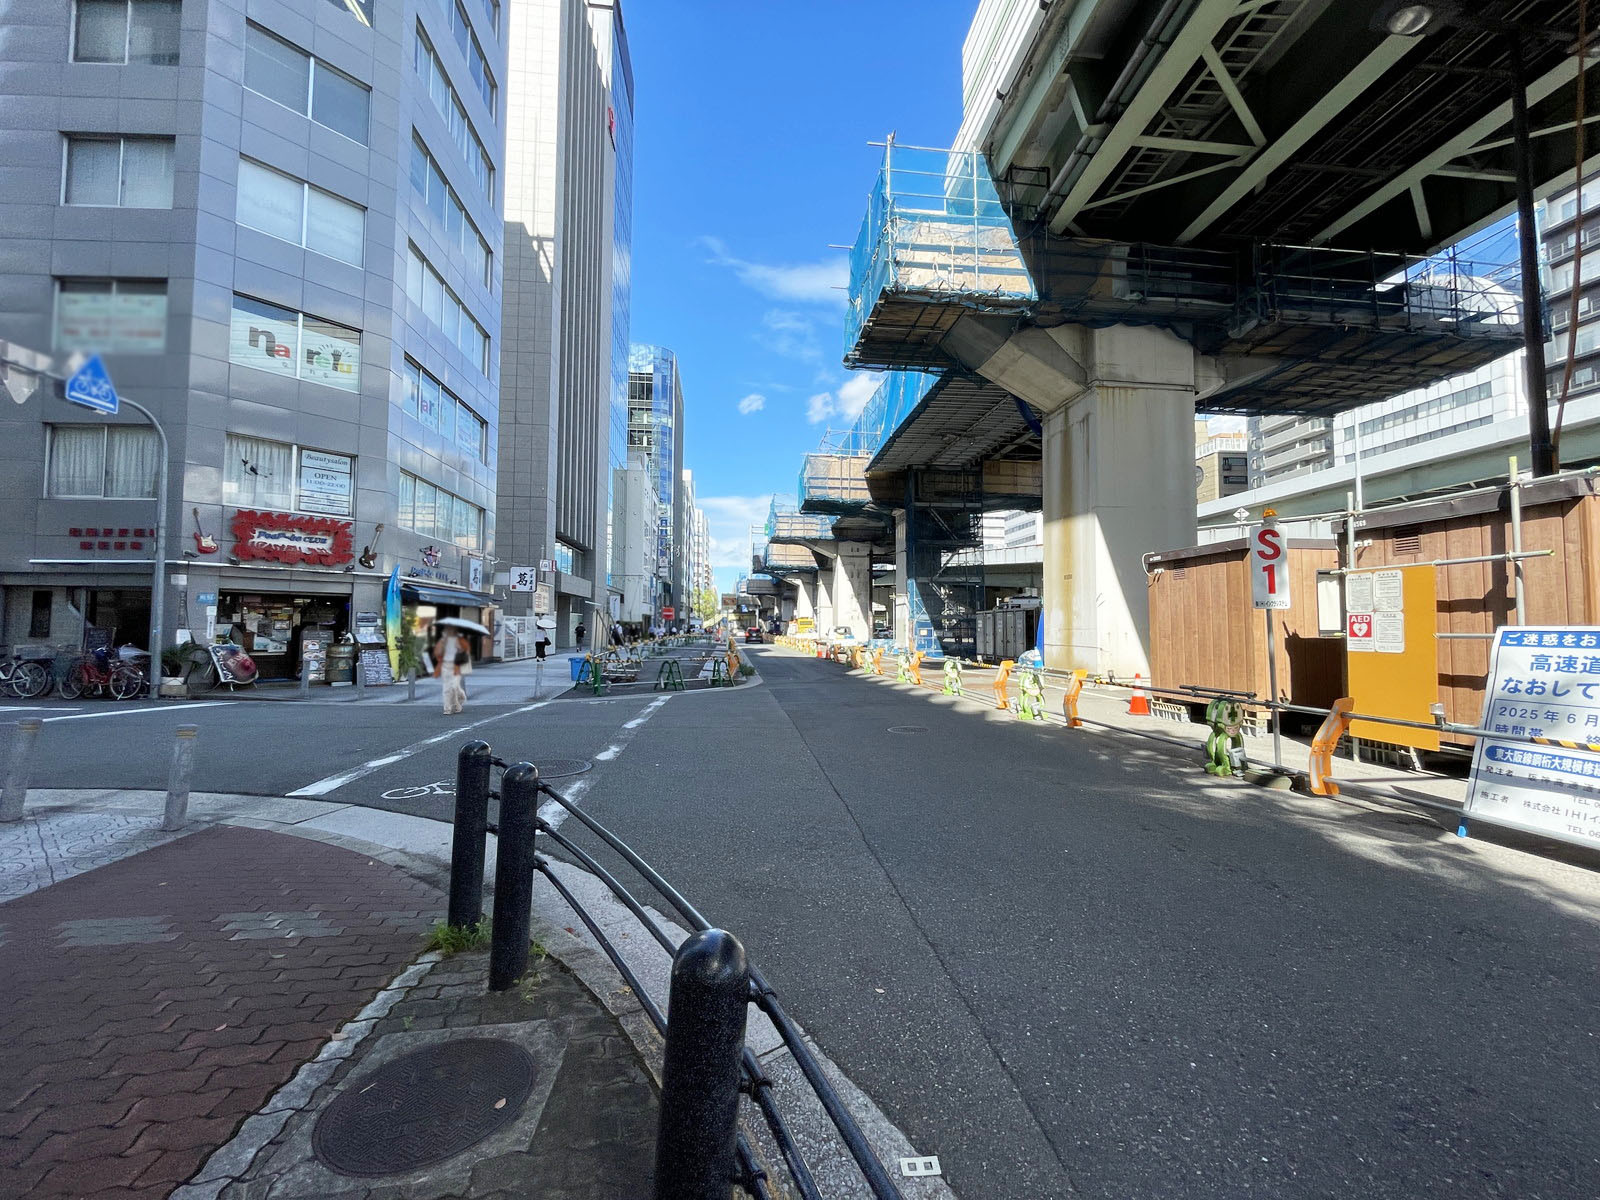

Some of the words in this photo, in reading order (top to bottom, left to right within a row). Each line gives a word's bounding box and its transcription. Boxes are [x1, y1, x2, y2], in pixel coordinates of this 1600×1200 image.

[314, 472, 337, 481] OPEN
[1350, 615, 1370, 623] AED
[1501, 677, 1600, 699] なおして
[1573, 796, 1591, 806] TEL
[1568, 825, 1585, 835] TEL
